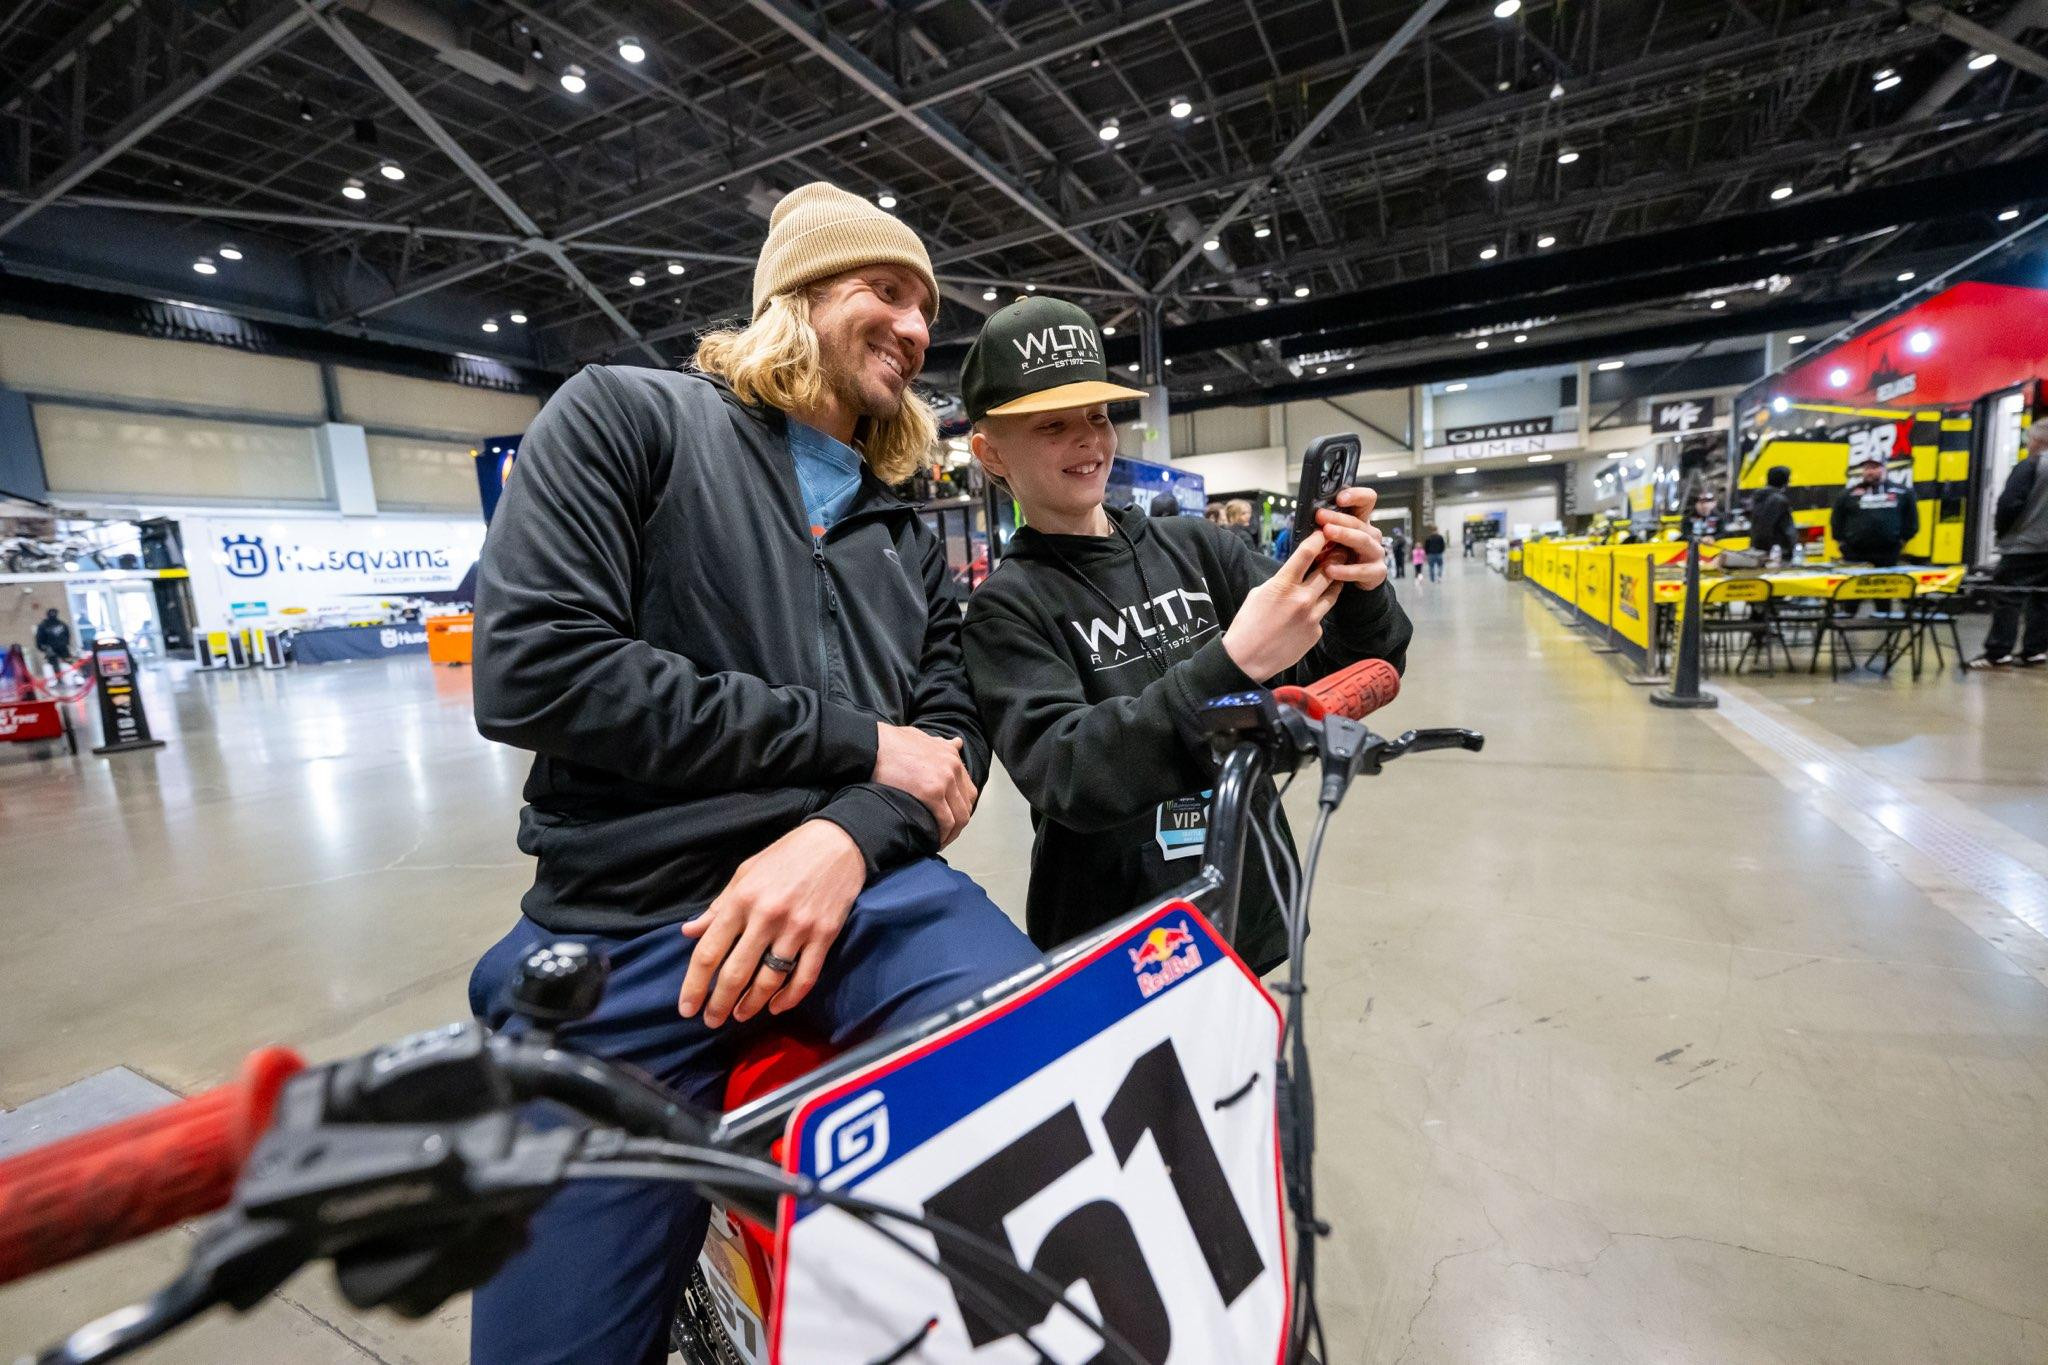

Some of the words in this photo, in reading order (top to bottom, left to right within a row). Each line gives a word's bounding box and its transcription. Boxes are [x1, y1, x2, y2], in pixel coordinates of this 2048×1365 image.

[1012, 325, 1098, 360] WLTN
[1021, 350, 1099, 370] RACEWAY
[1071, 577, 1213, 652] WLTN
[1090, 617, 1208, 665] RACEWA
[1168, 636, 1191, 650] 1972
[1173, 811, 1201, 829] VIP
[922, 1037, 1265, 1365] 51
